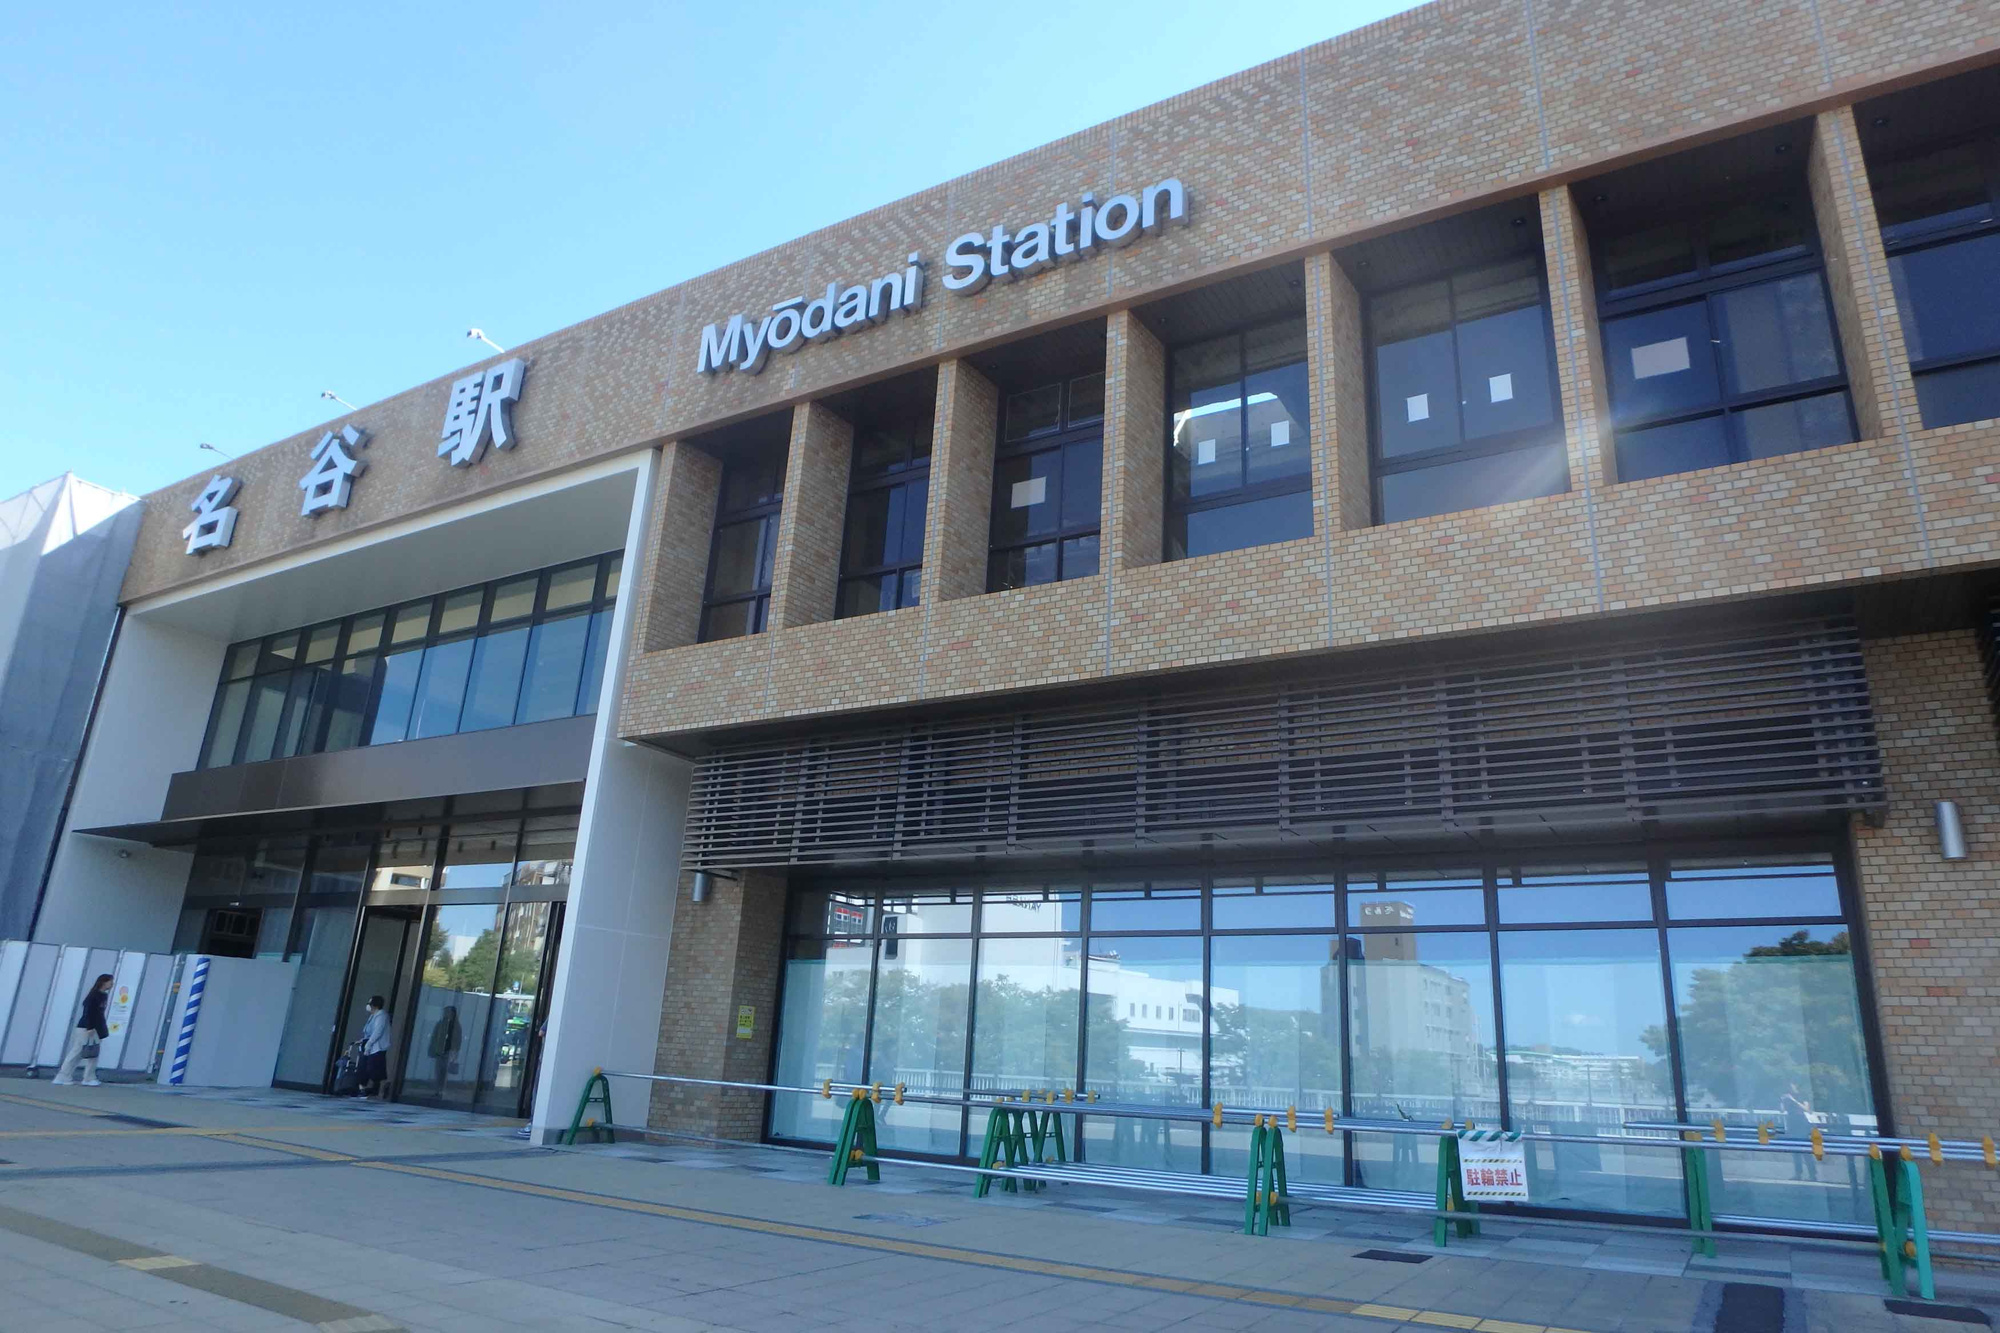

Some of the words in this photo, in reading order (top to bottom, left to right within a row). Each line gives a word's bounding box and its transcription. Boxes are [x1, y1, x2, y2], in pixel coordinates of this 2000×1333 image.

[696, 252, 924, 374] Myōdani
[942, 177, 1186, 291] Station
[183, 357, 525, 556] 名谷駅
[1466, 1168, 1523, 1186] 駐輪禁止
